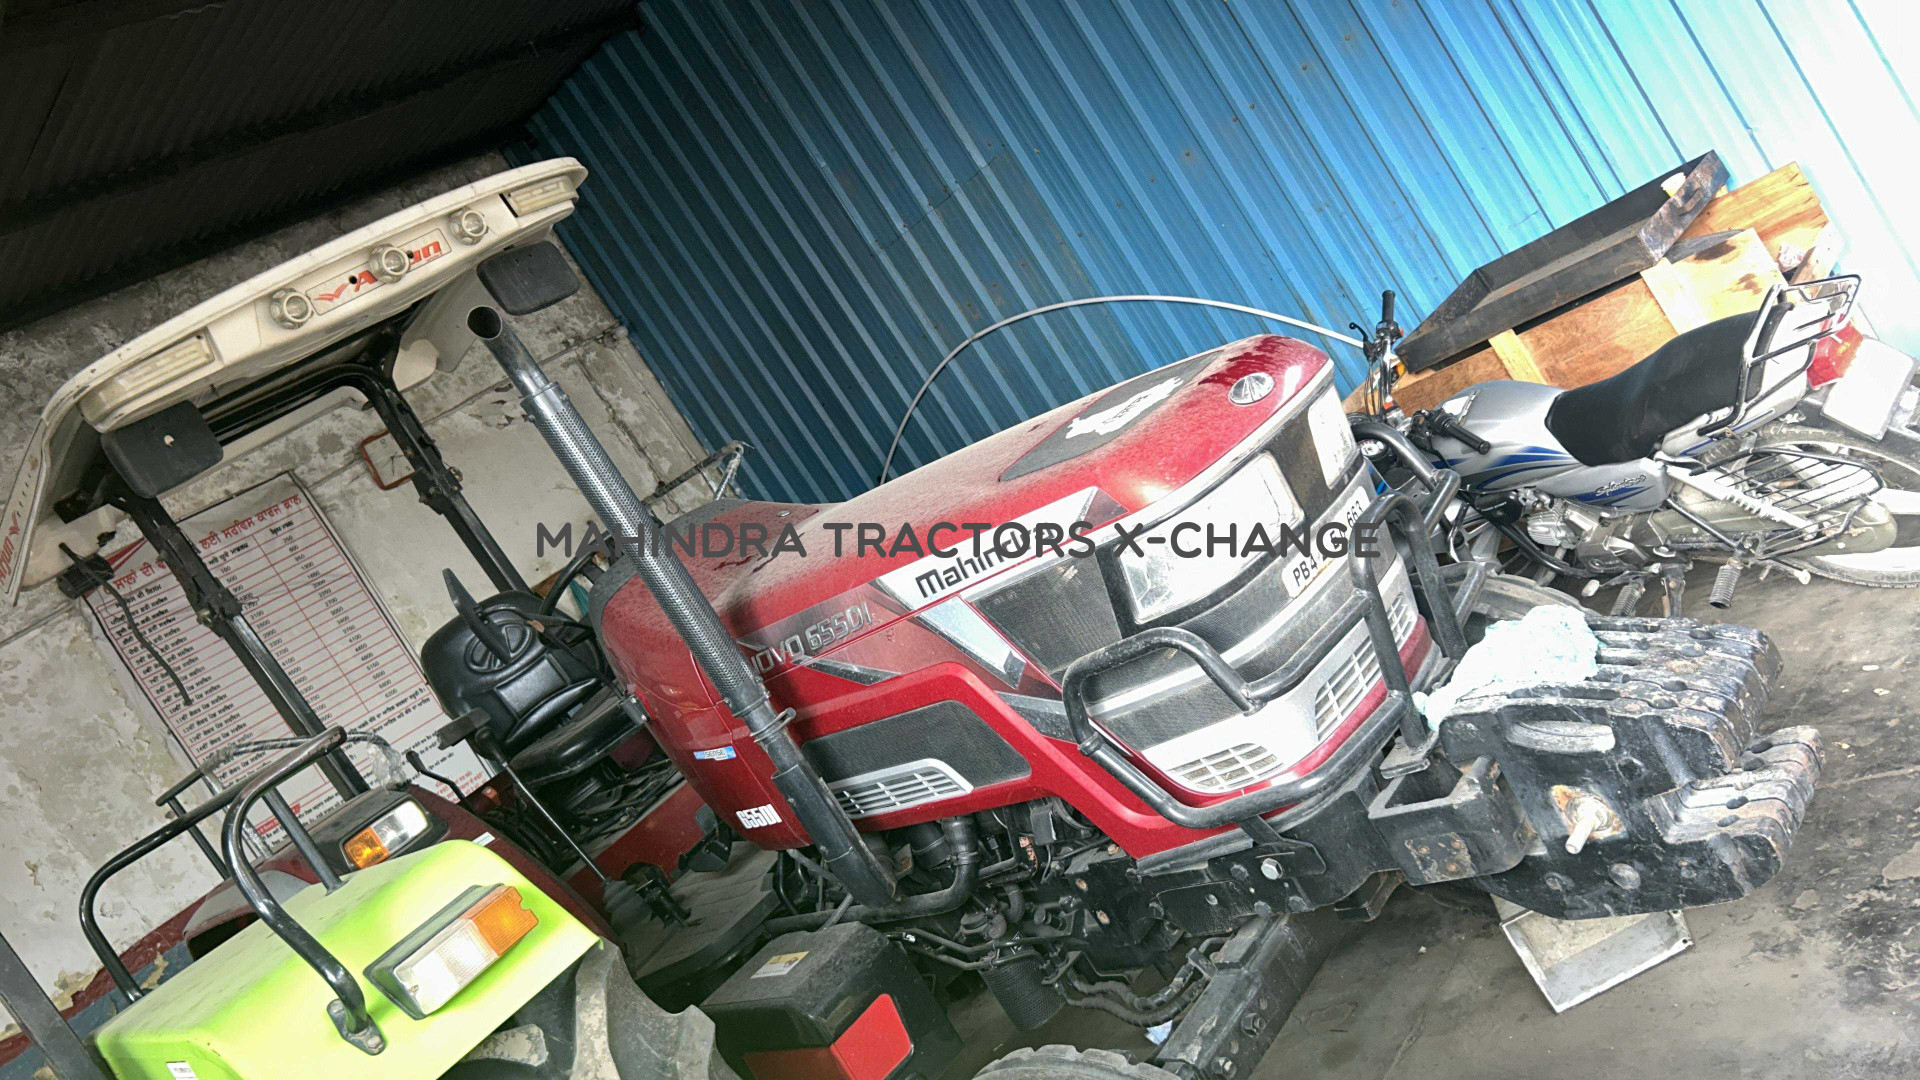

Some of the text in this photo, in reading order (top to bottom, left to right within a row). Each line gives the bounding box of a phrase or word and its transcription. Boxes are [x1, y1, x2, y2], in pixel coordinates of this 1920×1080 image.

[354, 241, 442, 293] Aun
[805, 601, 871, 651] 655DI
[735, 803, 783, 829] 655DI
